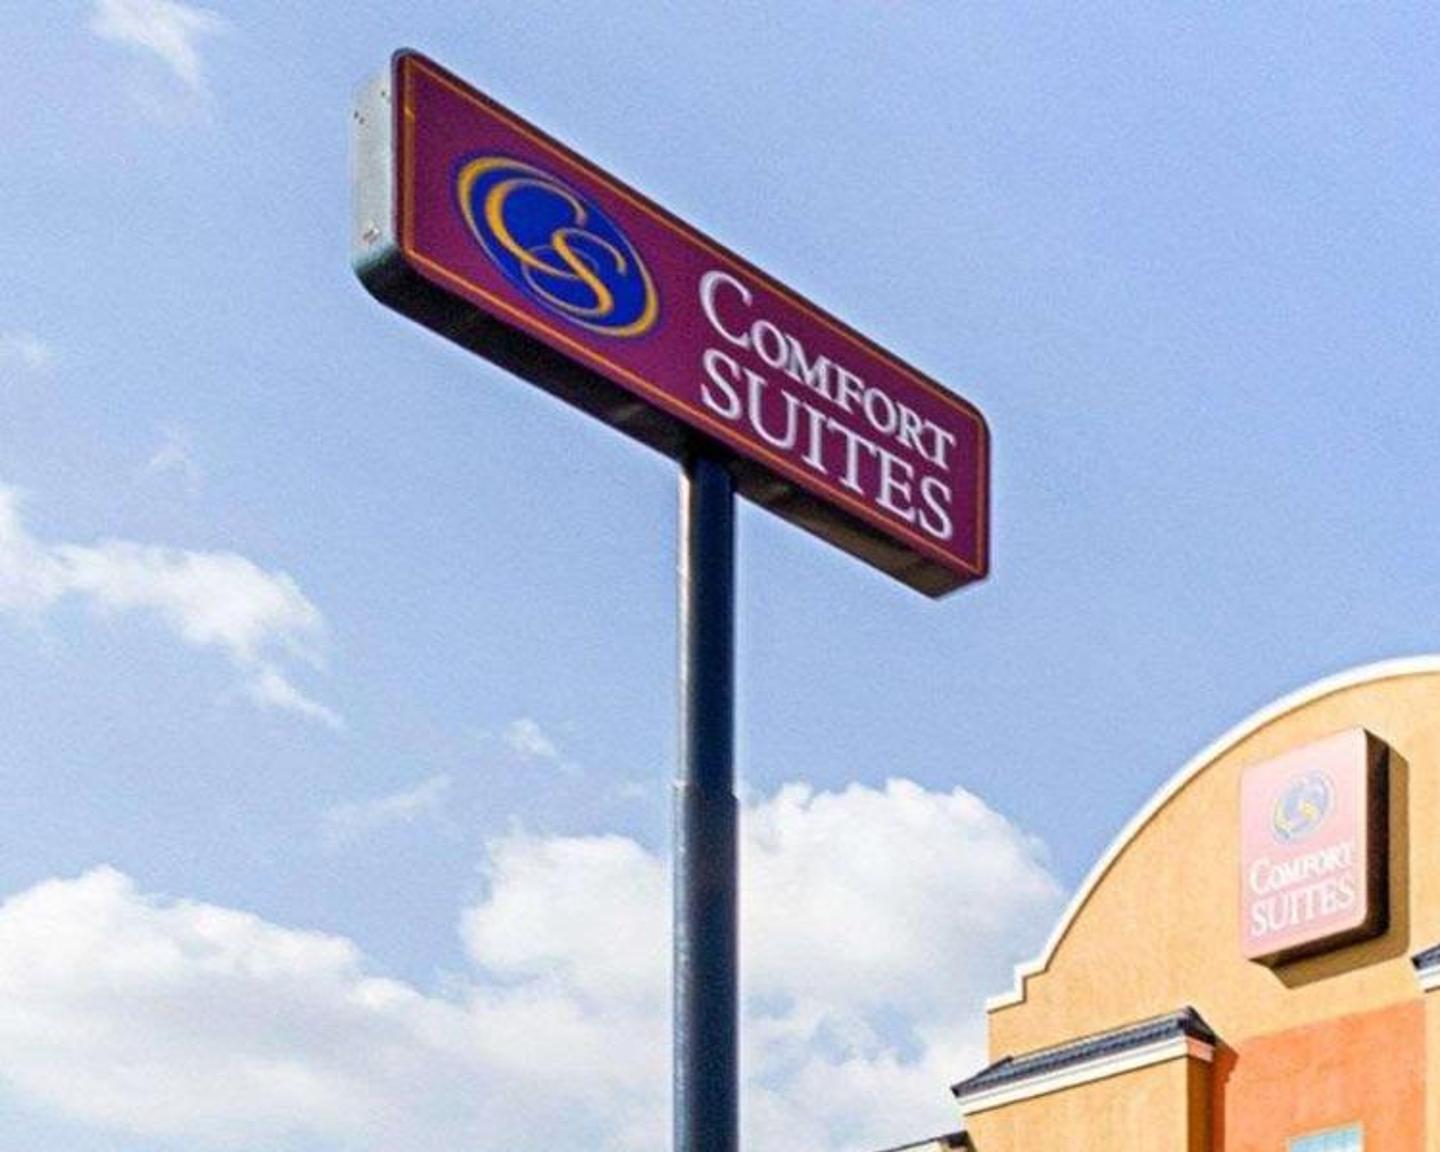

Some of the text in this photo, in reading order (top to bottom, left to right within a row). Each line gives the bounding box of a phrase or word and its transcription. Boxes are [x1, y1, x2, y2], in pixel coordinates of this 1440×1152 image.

[700, 269, 956, 471] COMFORT
[700, 348, 954, 541] SUITES
[1251, 841, 1353, 895] COMFORT
[1253, 877, 1354, 935] SUITES
